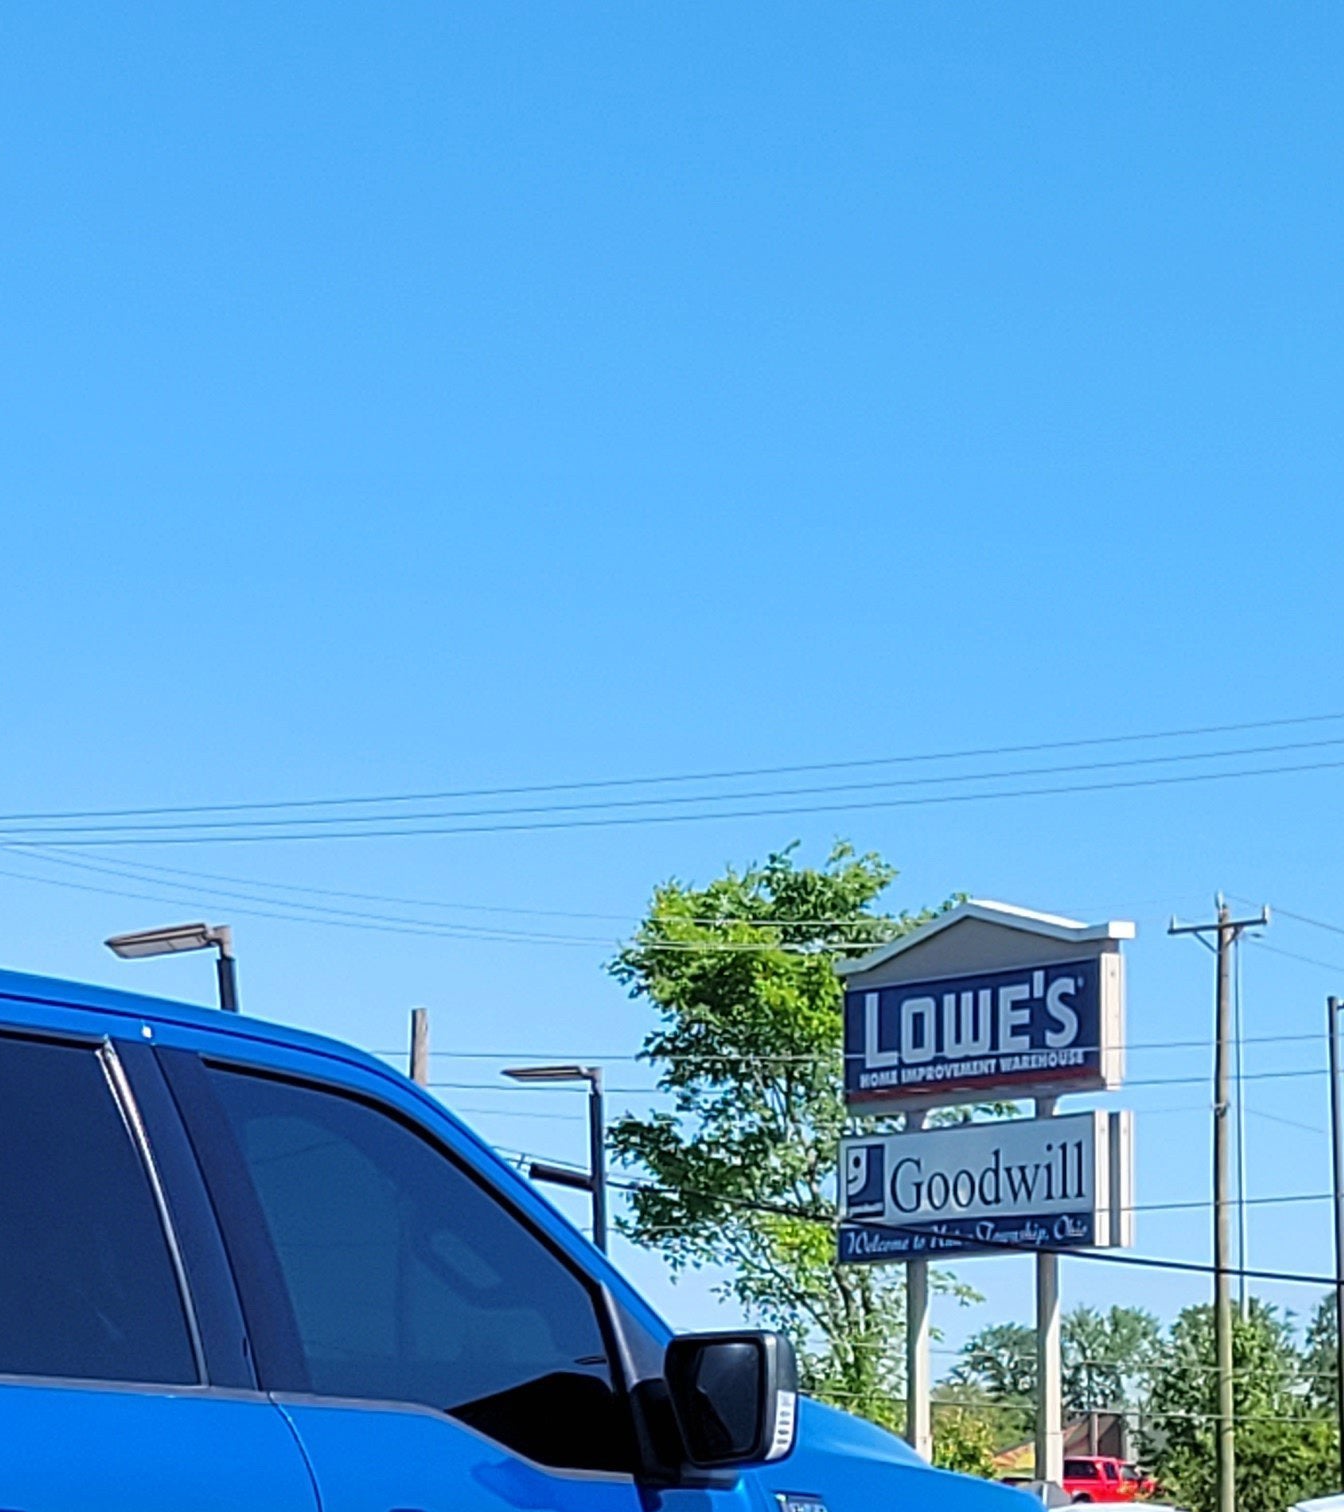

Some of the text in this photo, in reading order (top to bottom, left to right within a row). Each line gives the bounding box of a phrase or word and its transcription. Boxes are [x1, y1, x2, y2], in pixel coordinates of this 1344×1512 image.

[865, 969, 1079, 1069] LOWE'S
[859, 1049, 1085, 1089] HOME IMPROVEMENT WAREHOUSE
[890, 1140, 1087, 1213] Goodwill
